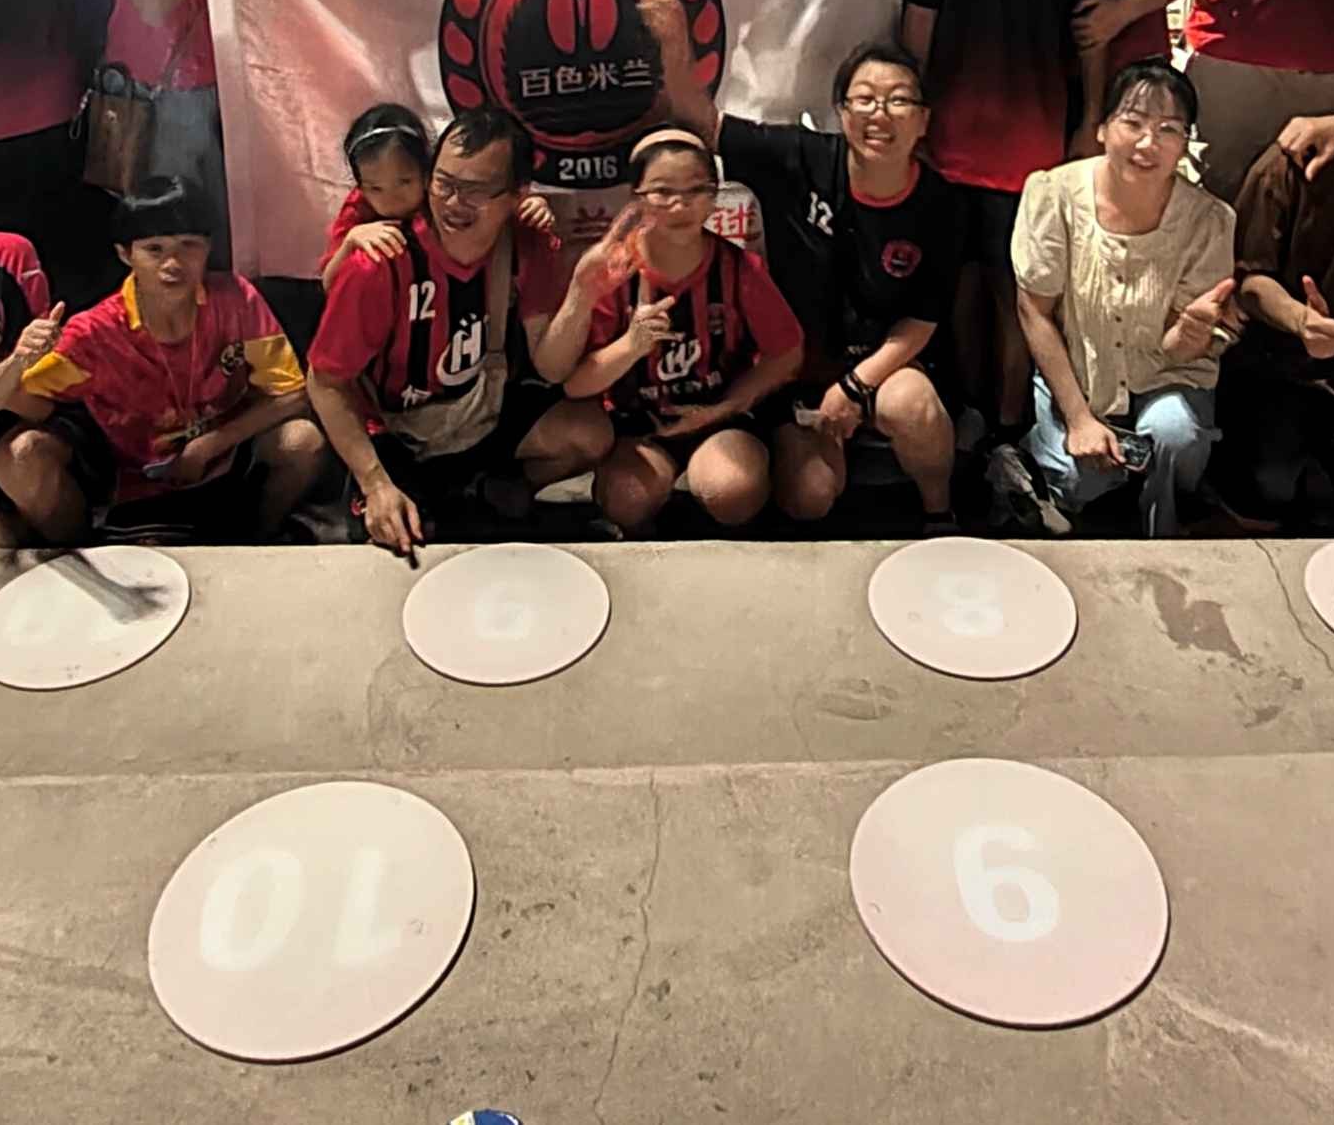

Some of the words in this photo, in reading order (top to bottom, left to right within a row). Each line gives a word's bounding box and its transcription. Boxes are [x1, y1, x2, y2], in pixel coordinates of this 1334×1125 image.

[519, 58, 653, 98] 百色米兰
[558, 154, 618, 181] 2016
[409, 279, 436, 322] 12
